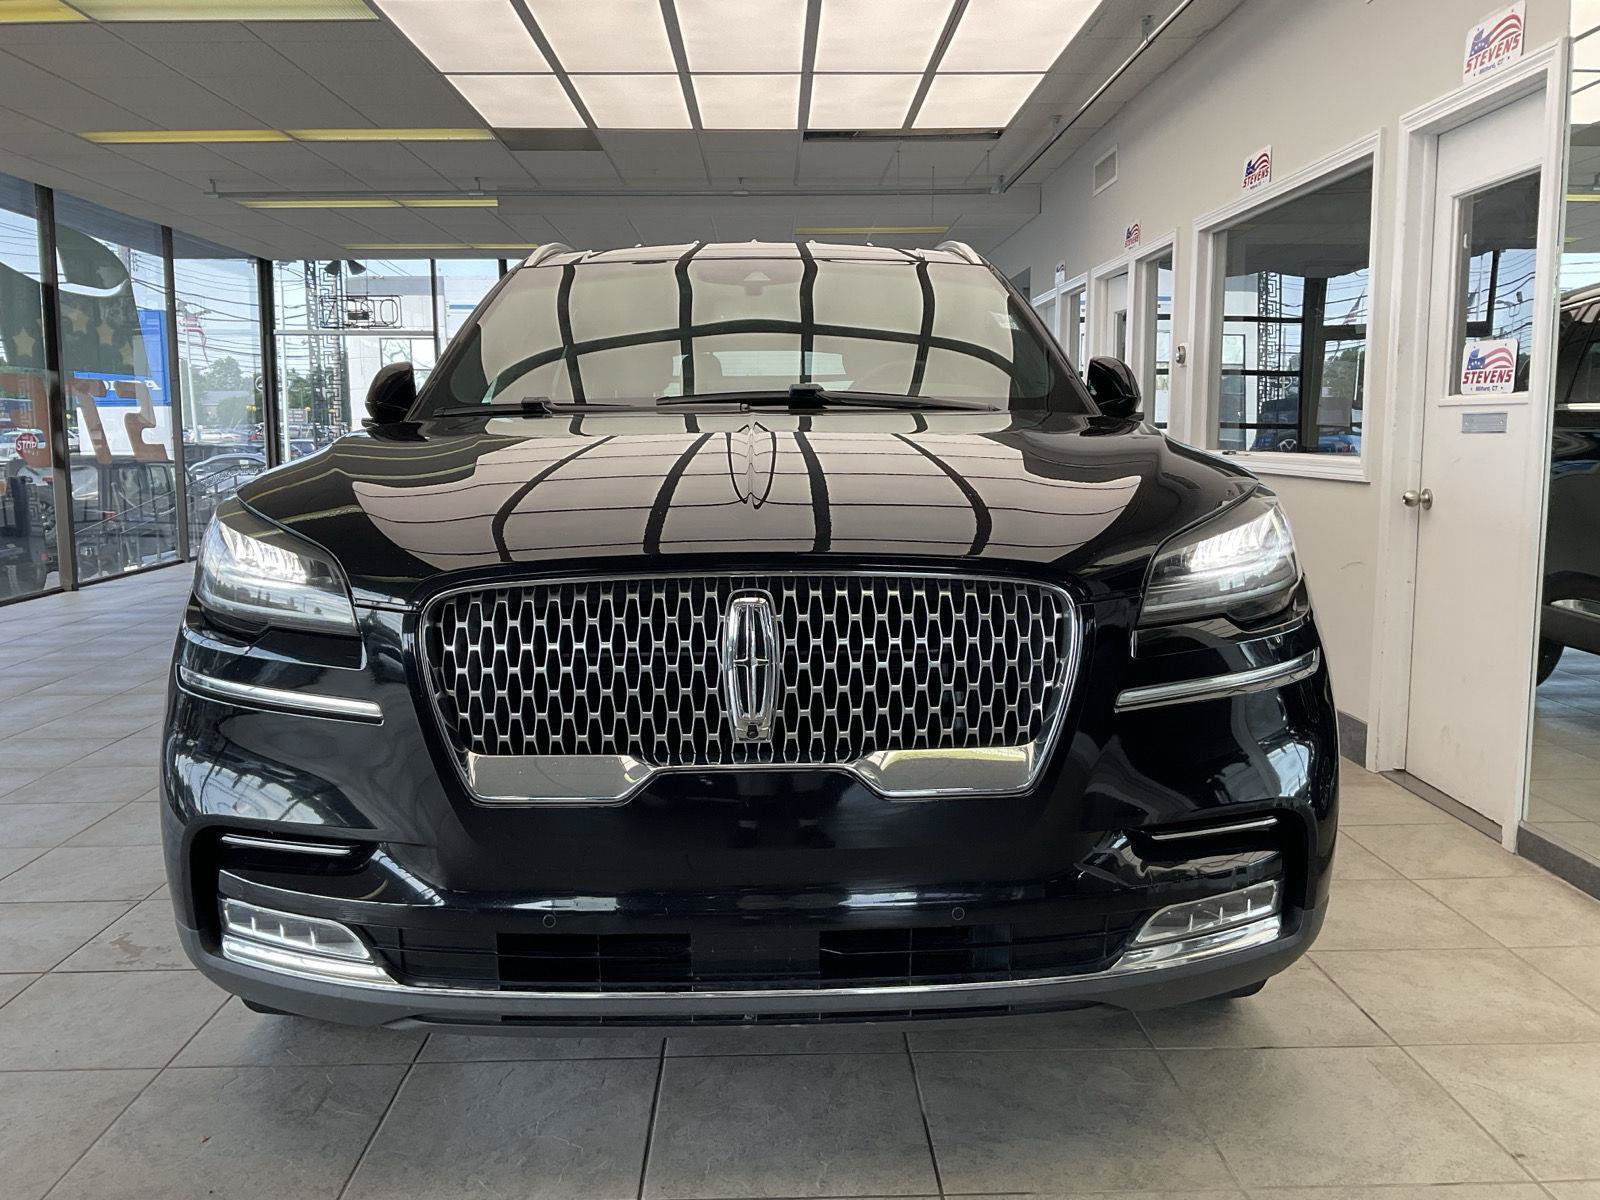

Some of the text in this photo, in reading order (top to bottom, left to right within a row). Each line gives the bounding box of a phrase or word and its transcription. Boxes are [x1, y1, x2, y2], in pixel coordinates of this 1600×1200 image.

[1464, 32, 1521, 74] STEVENS
[1242, 166, 1269, 188] STEVENS
[1462, 369, 1514, 384] STEVENS
[17, 440, 37, 451] STOP
